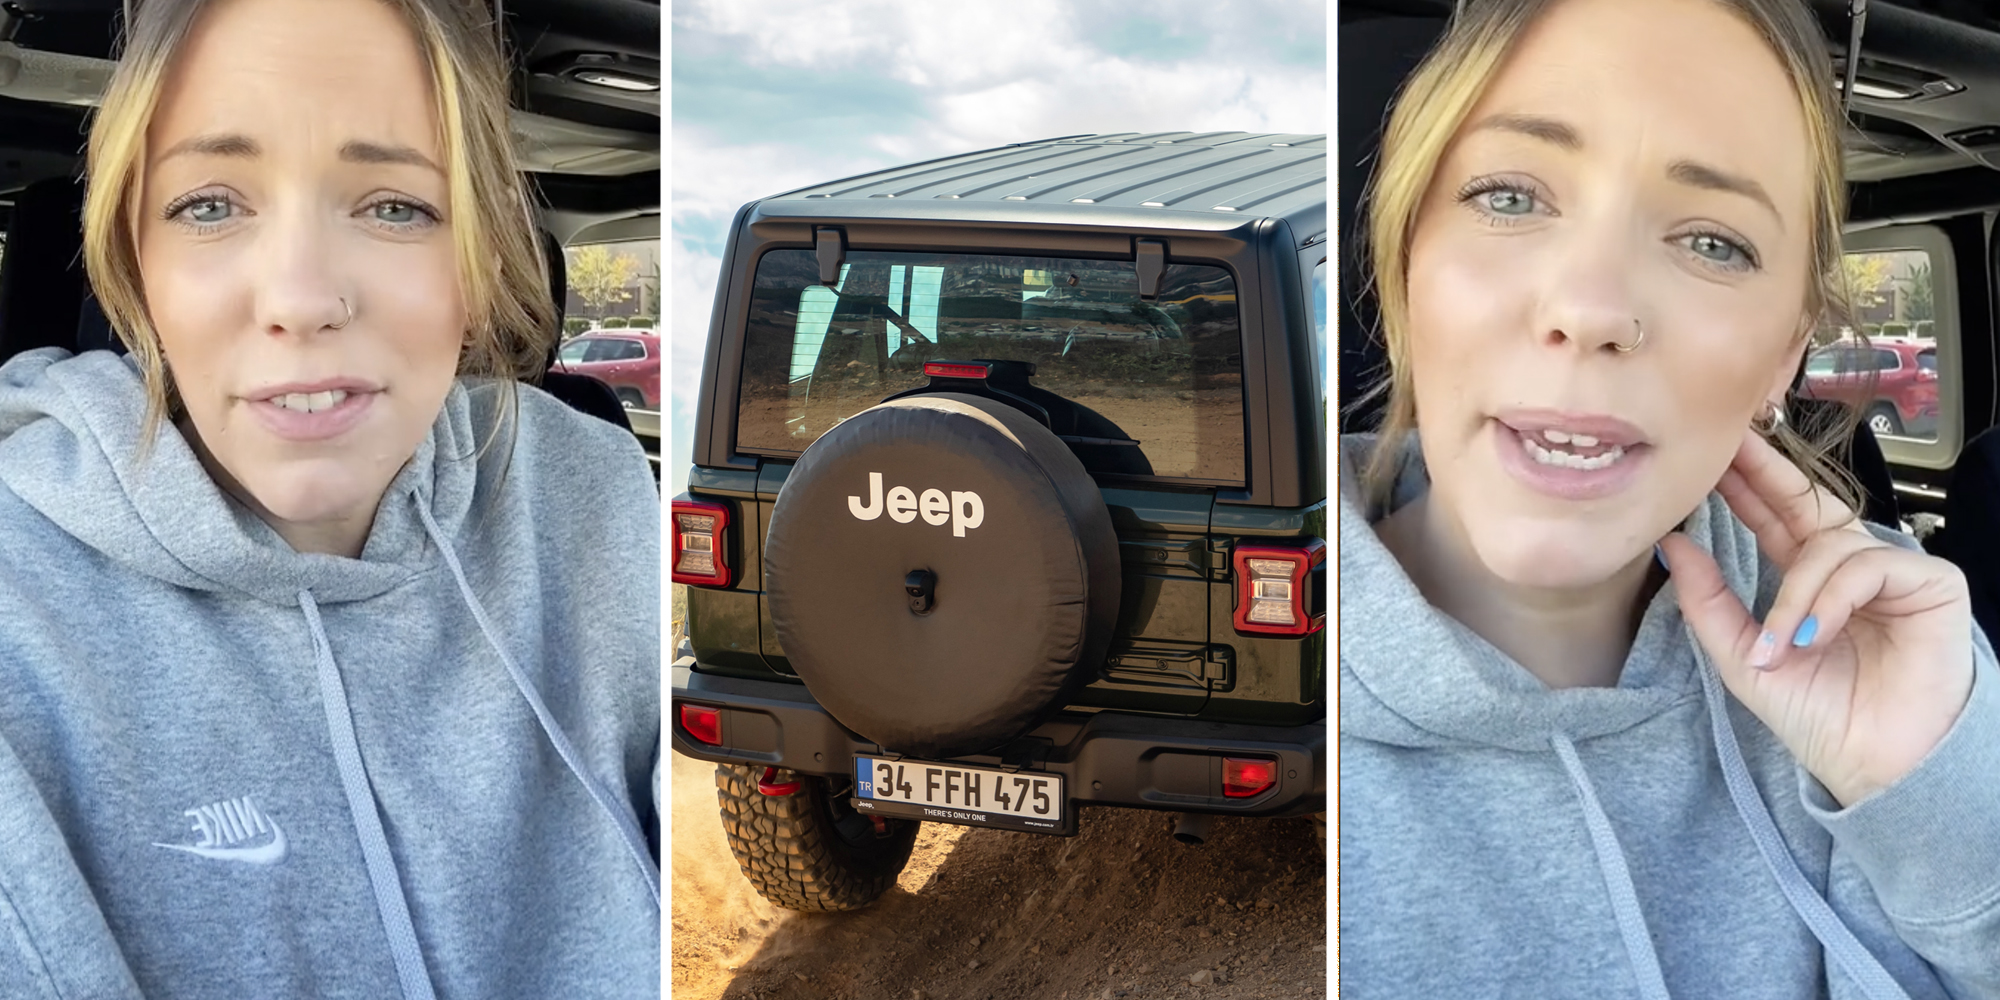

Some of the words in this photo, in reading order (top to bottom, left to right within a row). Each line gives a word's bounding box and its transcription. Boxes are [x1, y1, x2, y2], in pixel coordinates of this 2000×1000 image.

[848, 472, 985, 537] Jeep
[859, 781, 872, 791] TR
[877, 764, 912, 799] 34
[926, 768, 981, 807] FFH
[994, 776, 1050, 814] 475
[924, 808, 952, 818] THERE'S
[953, 811, 971, 820] ONLY
[971, 813, 986, 821] ONE
